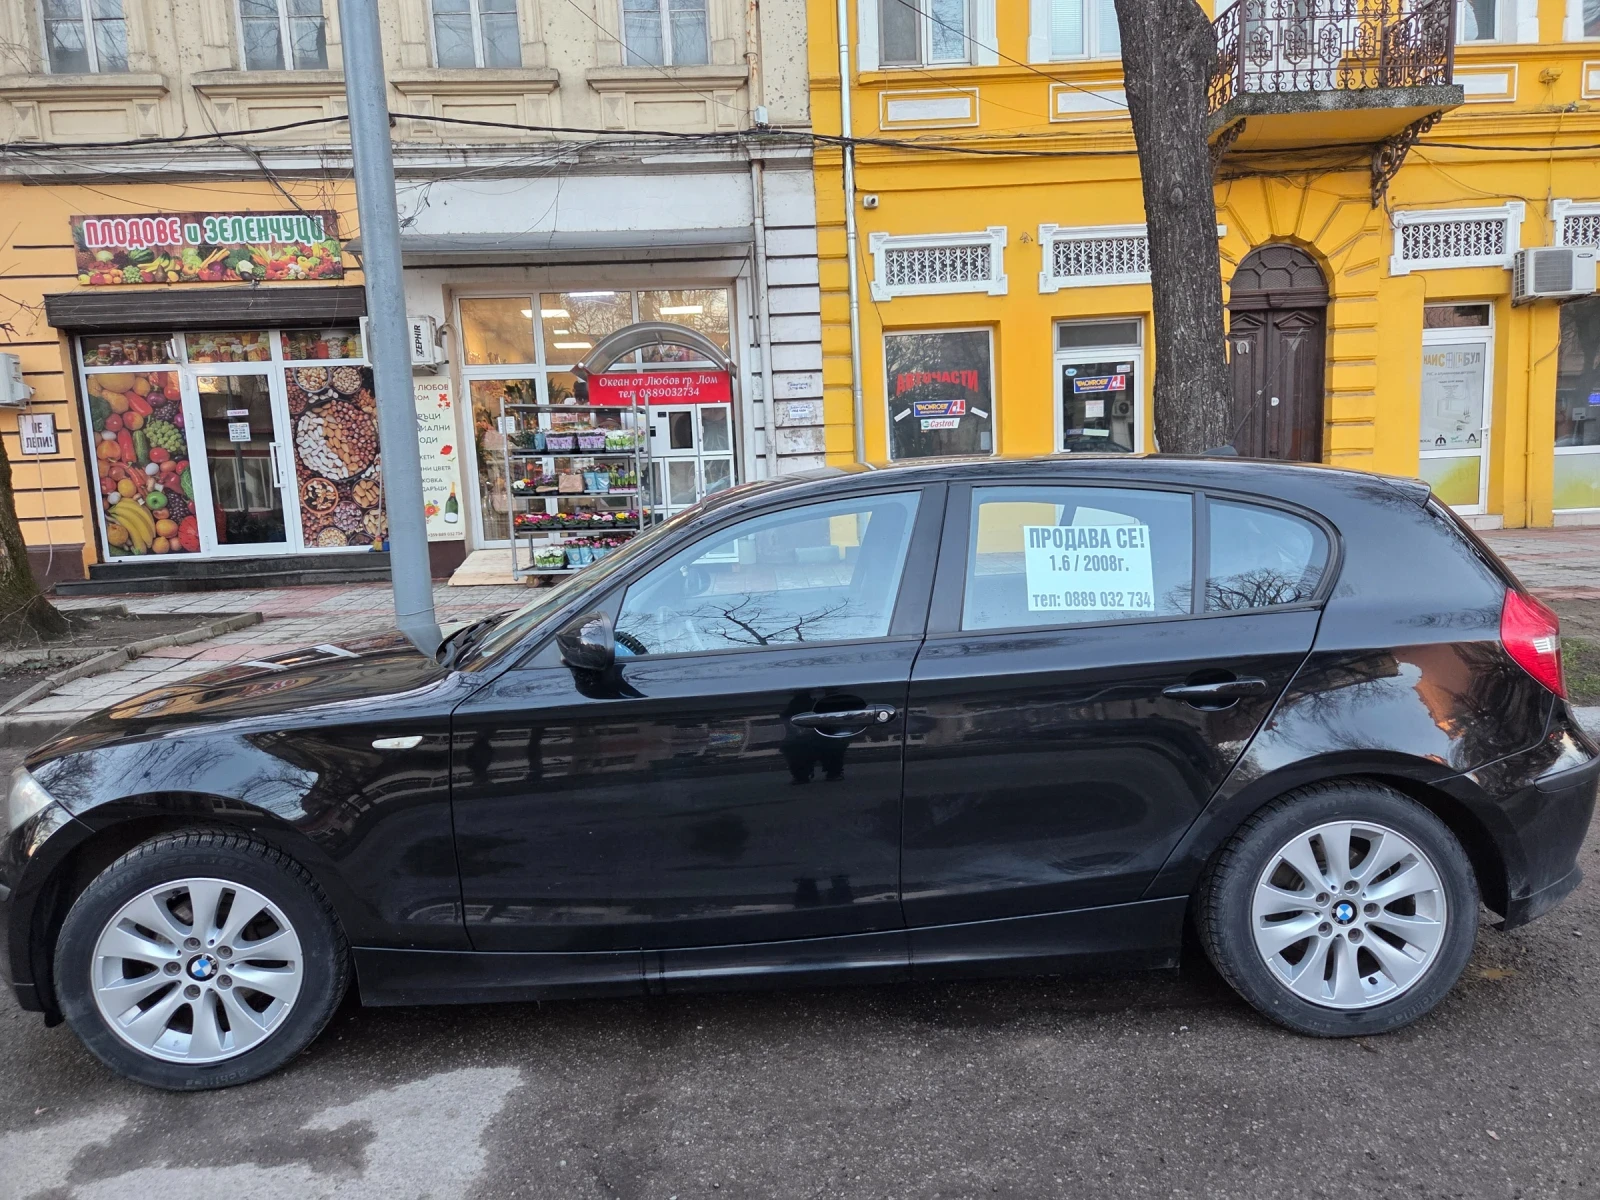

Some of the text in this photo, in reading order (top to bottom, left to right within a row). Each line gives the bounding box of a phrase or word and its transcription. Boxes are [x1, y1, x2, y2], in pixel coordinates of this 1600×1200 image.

[84, 216, 325, 248] ПЛОДОВЕ и ЗЕЛЕНЧУЦИ
[414, 324, 424, 357] ZEPHIR
[599, 377, 629, 387] Океан
[632, 378, 643, 386] от
[645, 376, 680, 386] Любов
[696, 375, 718, 384] Лом
[896, 369, 979, 397] АВТОЧАСТИ
[639, 387, 699, 398] 0889032734
[31, 422, 43, 433] НЕ
[930, 419, 955, 428] Castrol
[26, 436, 53, 448] ЛЕПИ!
[1029, 527, 1145, 551] ПРОДАВА СЕ!
[1049, 554, 1130, 572] 1.6 / 2008г.
[1032, 591, 1152, 608] тел: 0889 032 734
